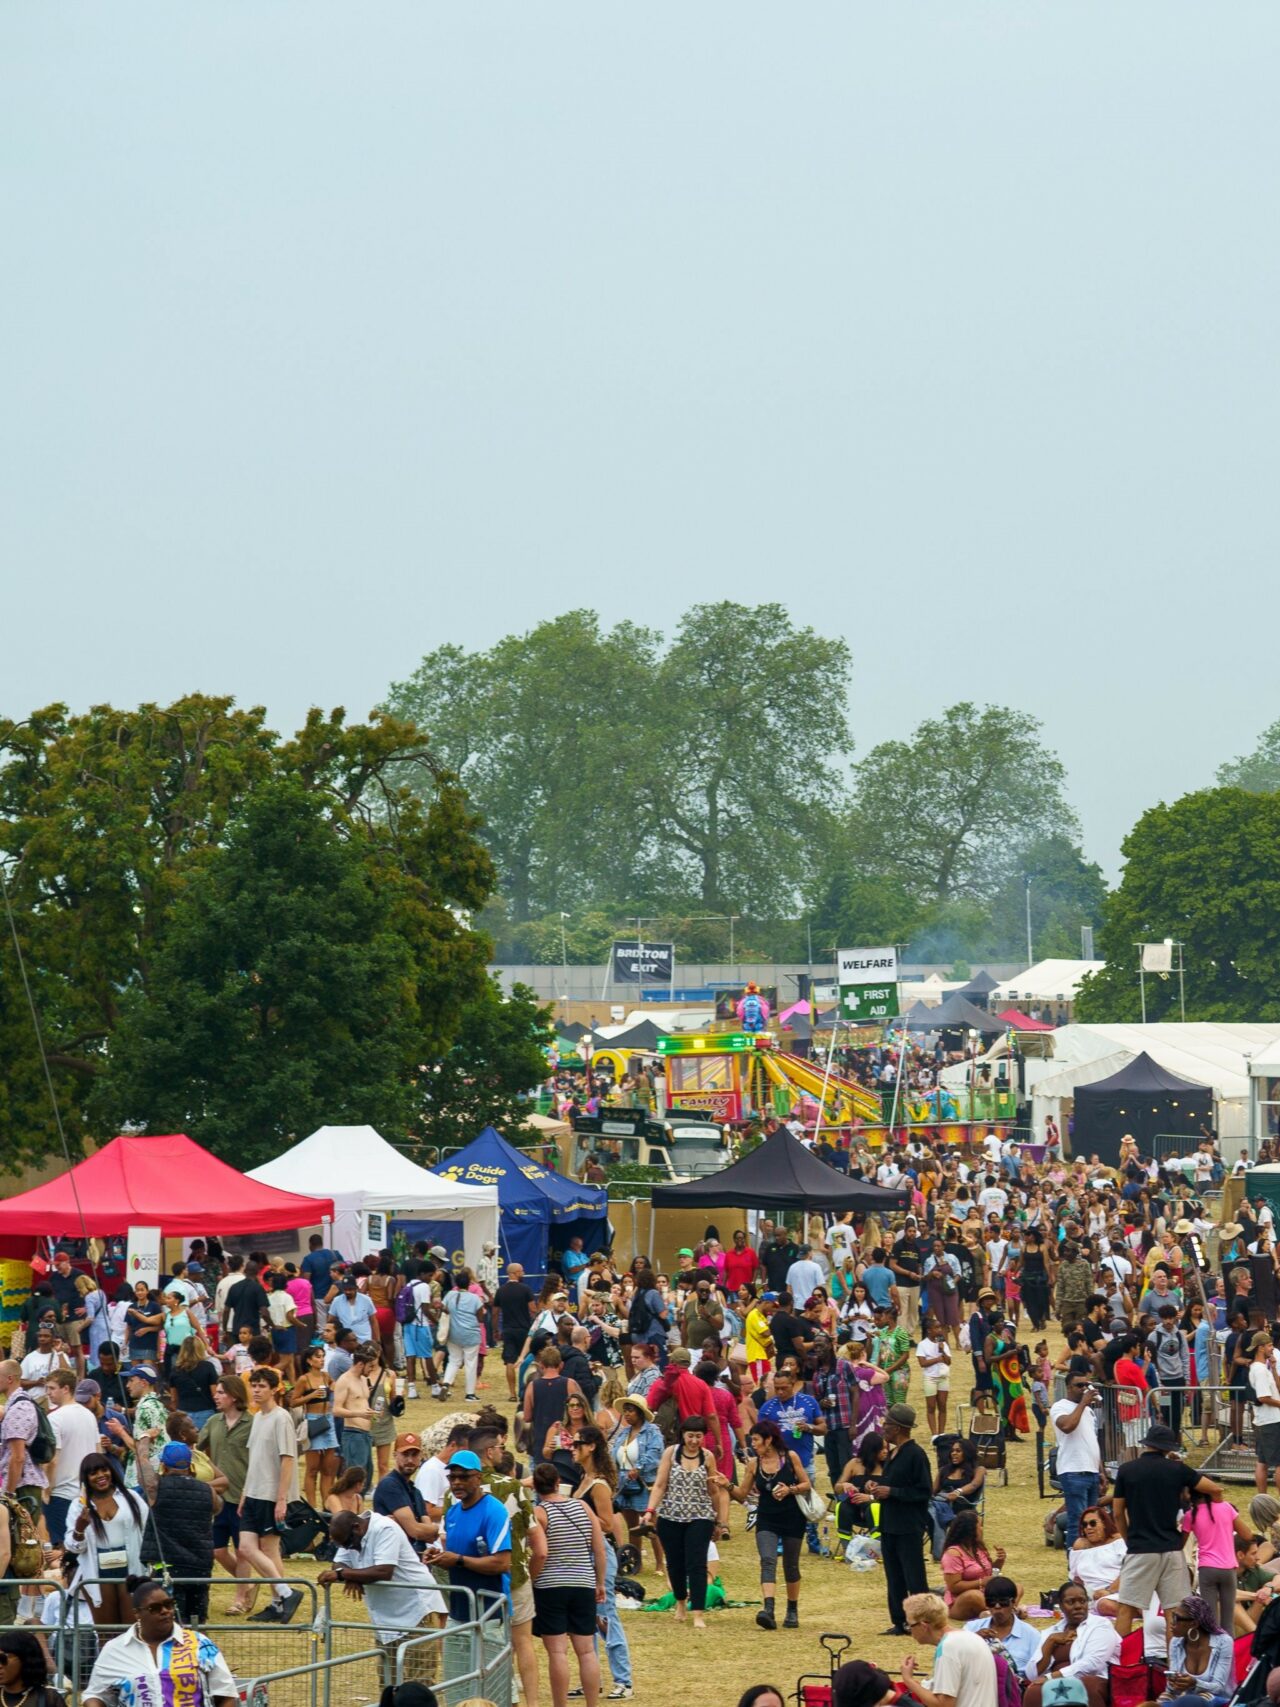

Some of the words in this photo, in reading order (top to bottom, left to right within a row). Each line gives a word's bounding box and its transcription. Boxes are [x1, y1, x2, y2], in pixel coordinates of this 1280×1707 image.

[617, 948, 669, 960] BRIXTON
[630, 963, 658, 973] EXIT
[842, 958, 894, 970] WELFARE
[863, 989, 891, 1000] FIRST
[870, 1005, 887, 1016] AID
[467, 1163, 507, 1177] Guide
[465, 1172, 499, 1185] Dogs
